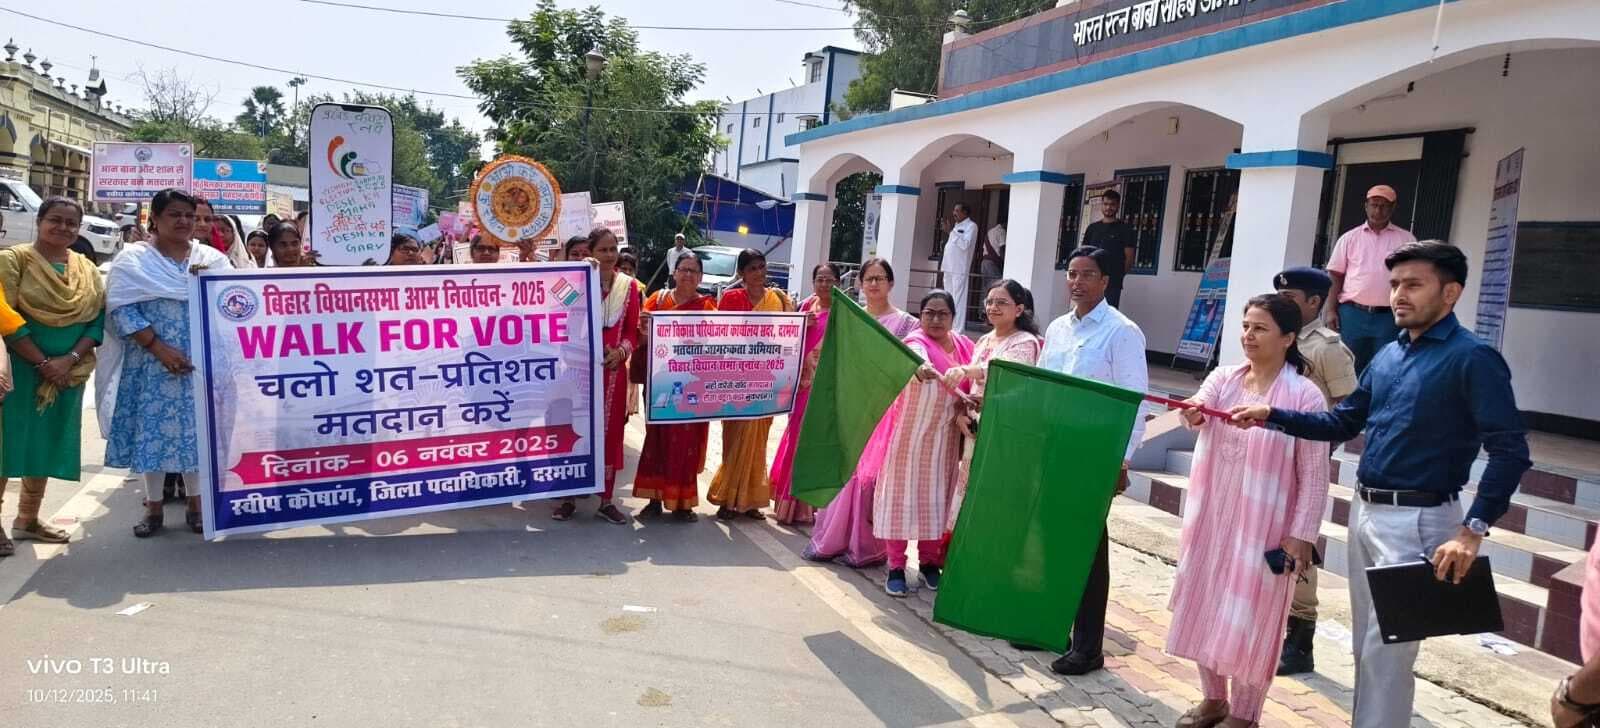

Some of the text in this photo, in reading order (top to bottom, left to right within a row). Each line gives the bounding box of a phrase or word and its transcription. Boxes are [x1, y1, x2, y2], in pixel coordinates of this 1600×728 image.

[1073, 15, 1103, 45] भारत
[1104, 7, 1129, 37] रत्न
[1131, 0, 1161, 29] बाबा
[101, 163, 185, 174] आन बान और शान से
[99, 178, 129, 187] सरकार
[146, 178, 175, 187] मतदान
[176, 177, 185, 187] से
[326, 197, 356, 213] DESH
[333, 231, 364, 244] DESH
[346, 243, 385, 253] GARV
[262, 284, 311, 316] बिहार
[314, 282, 400, 314] विधानसभा
[405, 285, 441, 311] आम
[442, 278, 507, 309] निर्वाचन-
[511, 280, 545, 306] 2025
[237, 312, 569, 360] WALK FOR VOTE
[656, 324, 671, 338] बाल
[672, 321, 695, 338] विकास
[696, 320, 729, 337] परियोजना
[730, 320, 760, 337] कार्यालय
[778, 321, 800, 337] दरभंगा
[672, 344, 703, 356] मतदाता
[748, 341, 782, 355] अभियान
[668, 359, 691, 373] बिहार
[692, 358, 718, 372] विधान
[719, 359, 736, 371] सभा
[766, 359, 785, 370] 2025
[254, 360, 339, 400] चलो
[313, 390, 514, 437] मतदान करें
[376, 449, 409, 467] 06
[417, 439, 490, 463] नवंबर
[499, 434, 559, 455] 2025
[229, 460, 587, 516] स्वीप कोषांग, जिला पदाधिकारी, दरभंगा
